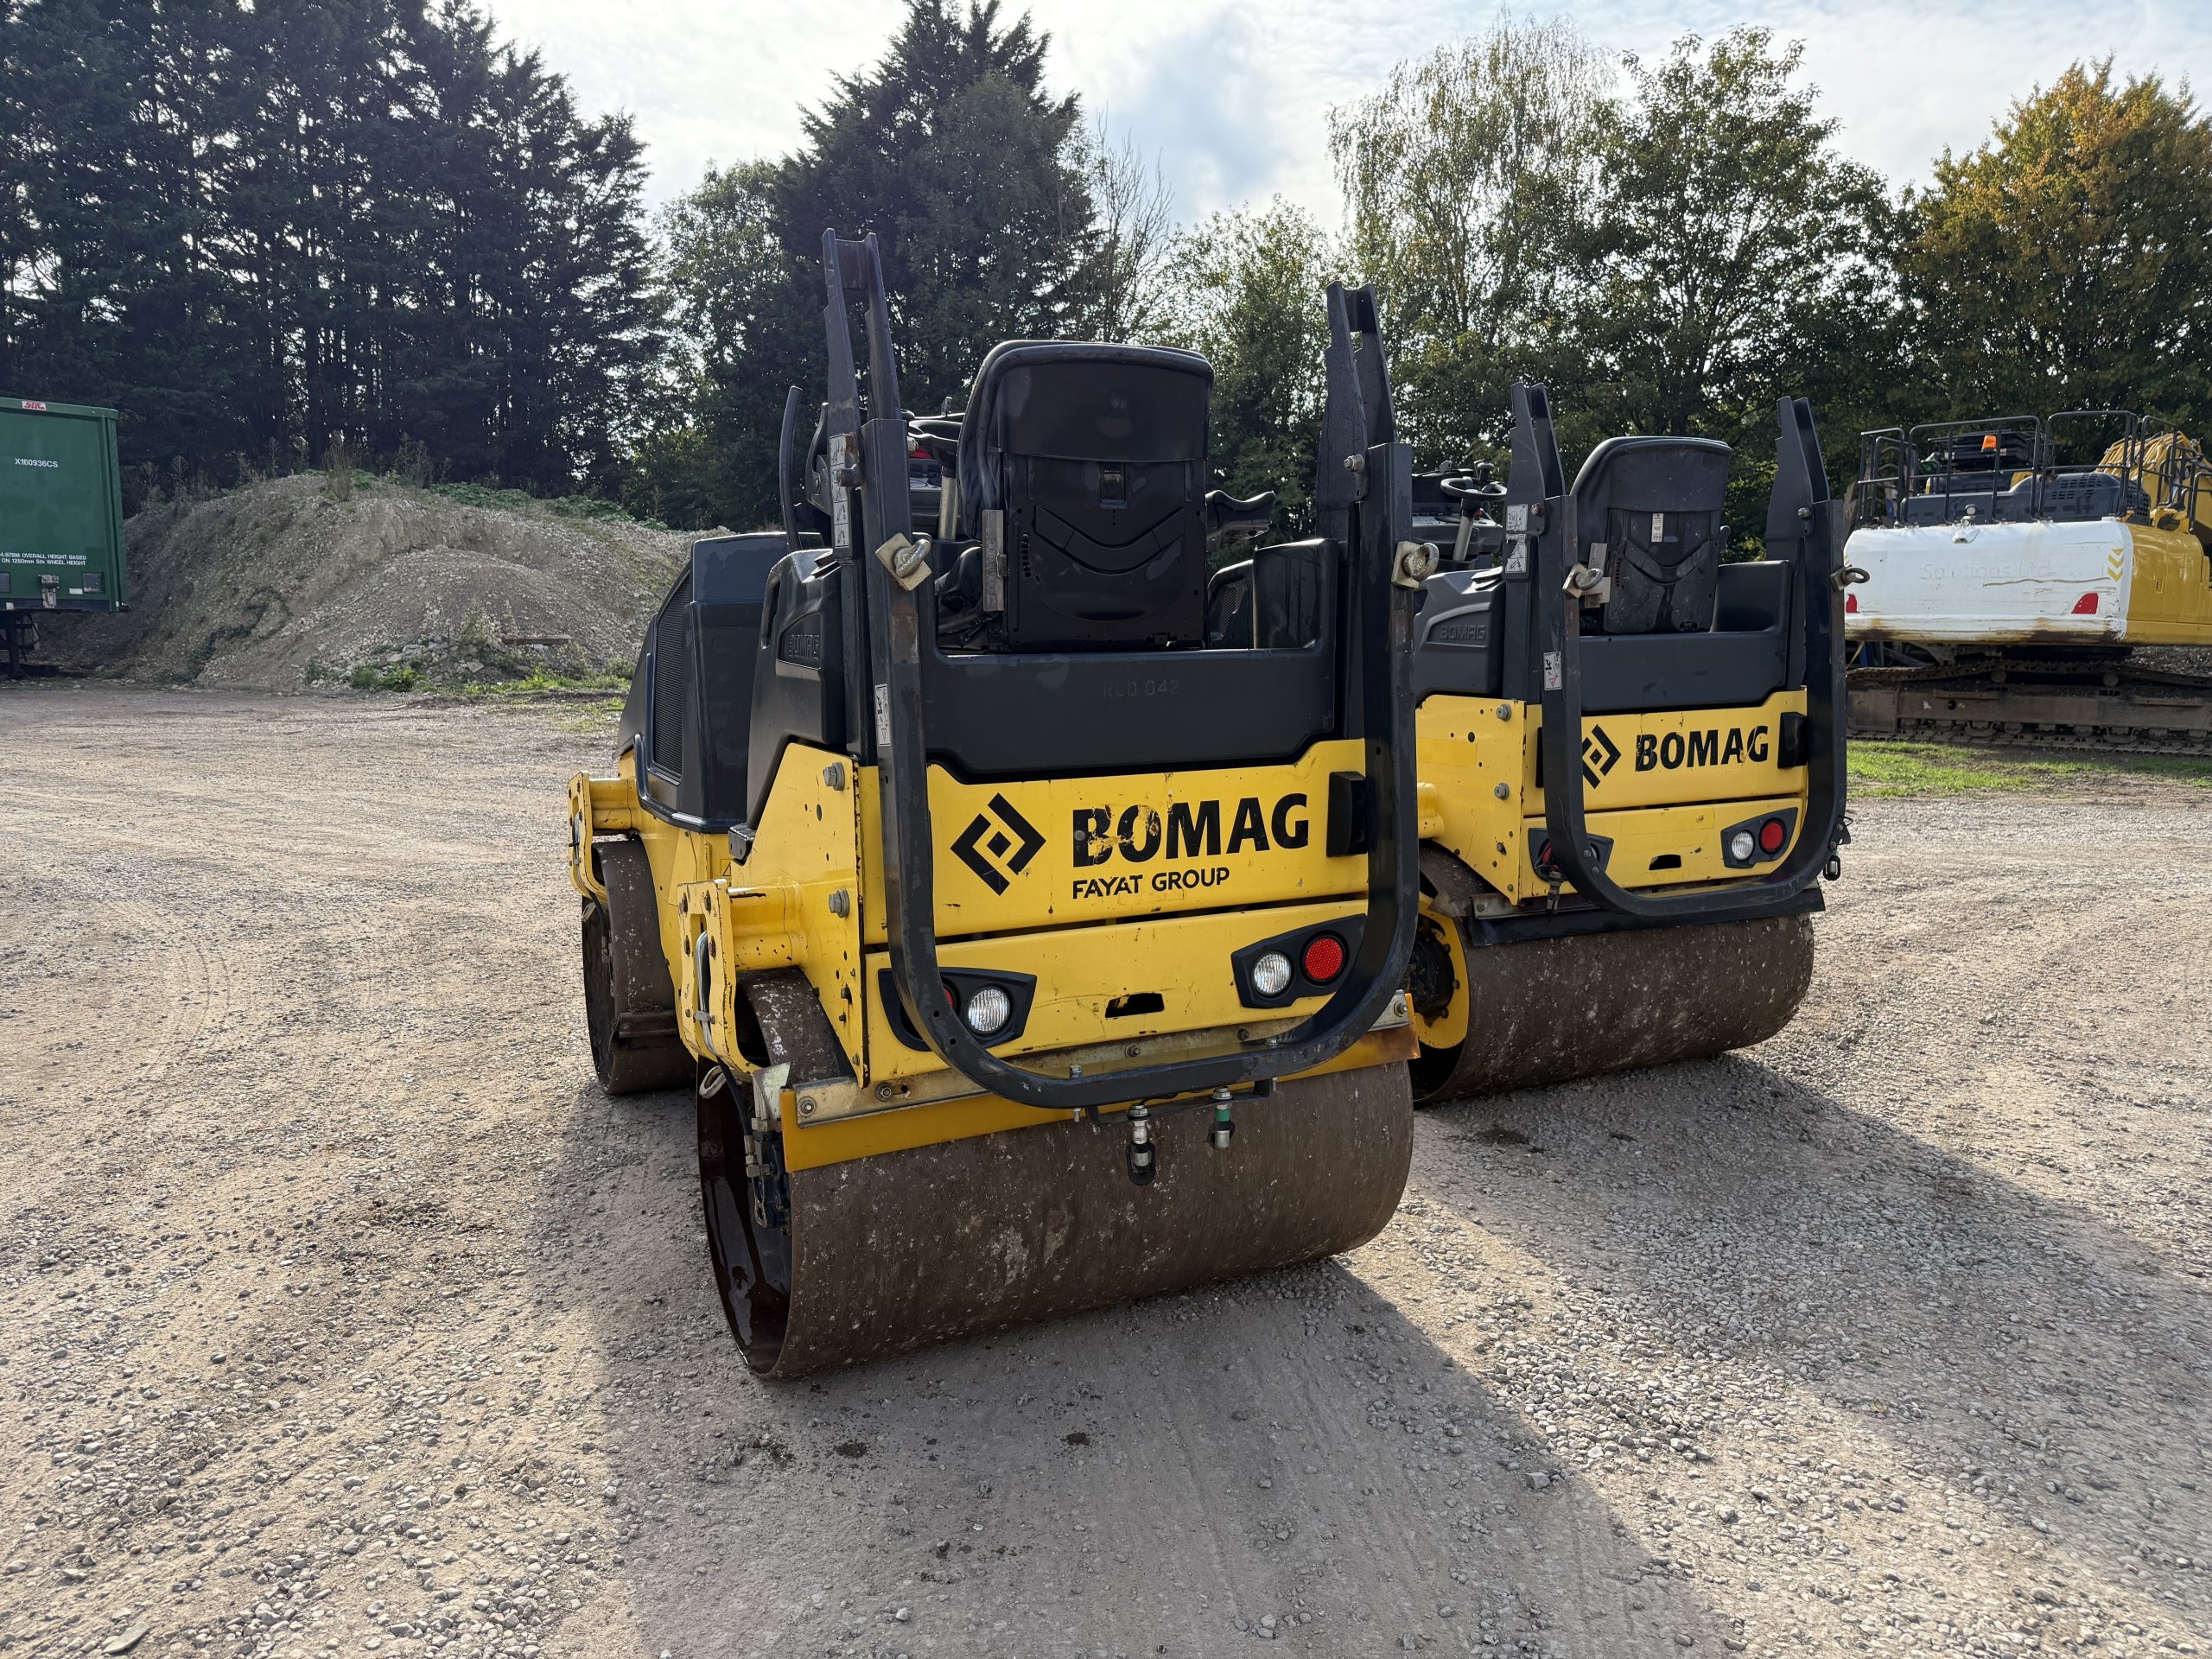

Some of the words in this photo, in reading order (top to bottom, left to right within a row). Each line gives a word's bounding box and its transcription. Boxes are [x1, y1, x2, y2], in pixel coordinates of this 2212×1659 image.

[15, 458, 59, 468] X160936CS
[1923, 562, 2010, 580] Solutions
[1440, 624, 1487, 641] BOMAG
[787, 633, 820, 660] BOMAG
[1145, 678, 1181, 696] 042
[1635, 725, 1769, 772] BOMAG
[1072, 792, 1309, 867] BOMAG
[1072, 874, 1143, 899] FAYAT
[1151, 867, 1230, 892] GROUP
